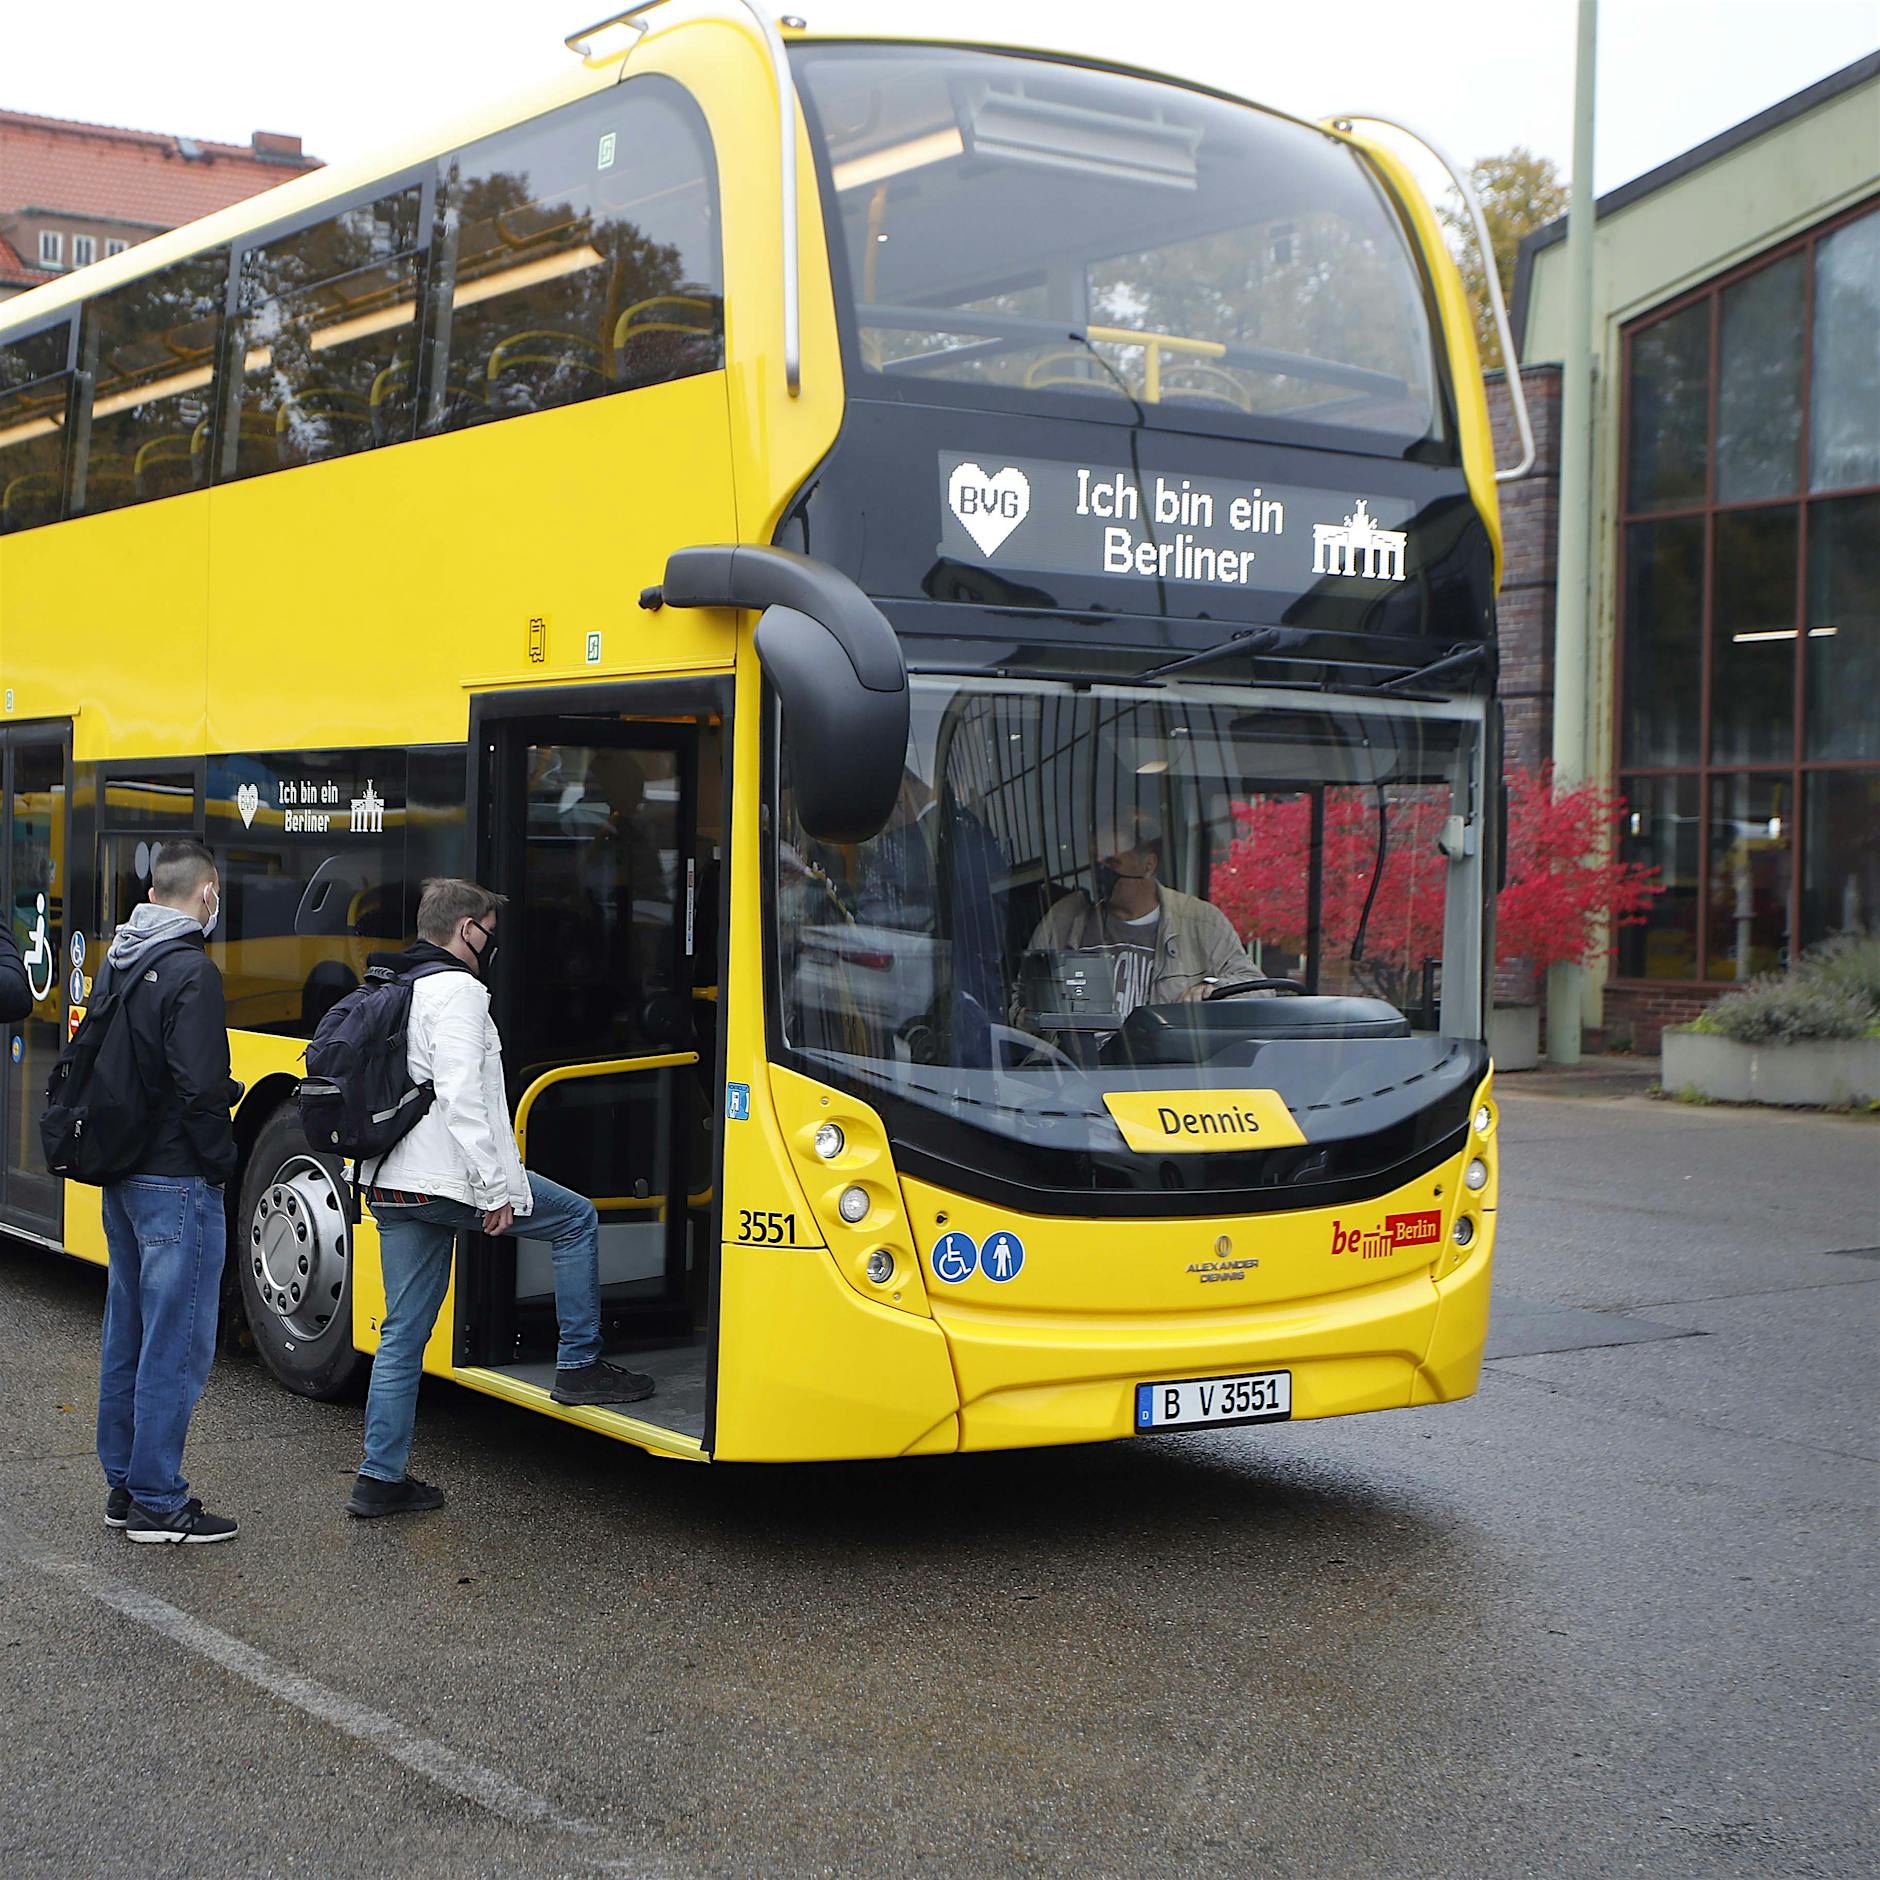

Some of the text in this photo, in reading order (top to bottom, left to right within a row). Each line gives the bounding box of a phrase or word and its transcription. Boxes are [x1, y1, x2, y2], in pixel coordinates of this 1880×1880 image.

[960, 484, 1019, 519] BVG
[1076, 469, 1284, 534] Ich bin ein
[1103, 527, 1255, 584] Berliner
[279, 781, 297, 804] Ich
[300, 781, 318, 804] bin
[321, 780, 338, 804] ein
[284, 809, 330, 832] Berliner
[1158, 1106, 1259, 1134] Dennis
[738, 1210, 795, 1244] 3551
[1395, 1219, 1436, 1240] Berlin
[1186, 1259, 1259, 1272] ALEXANDER
[1200, 1271, 1245, 1283] DENNIS
[1142, 1411, 1149, 1420] D
